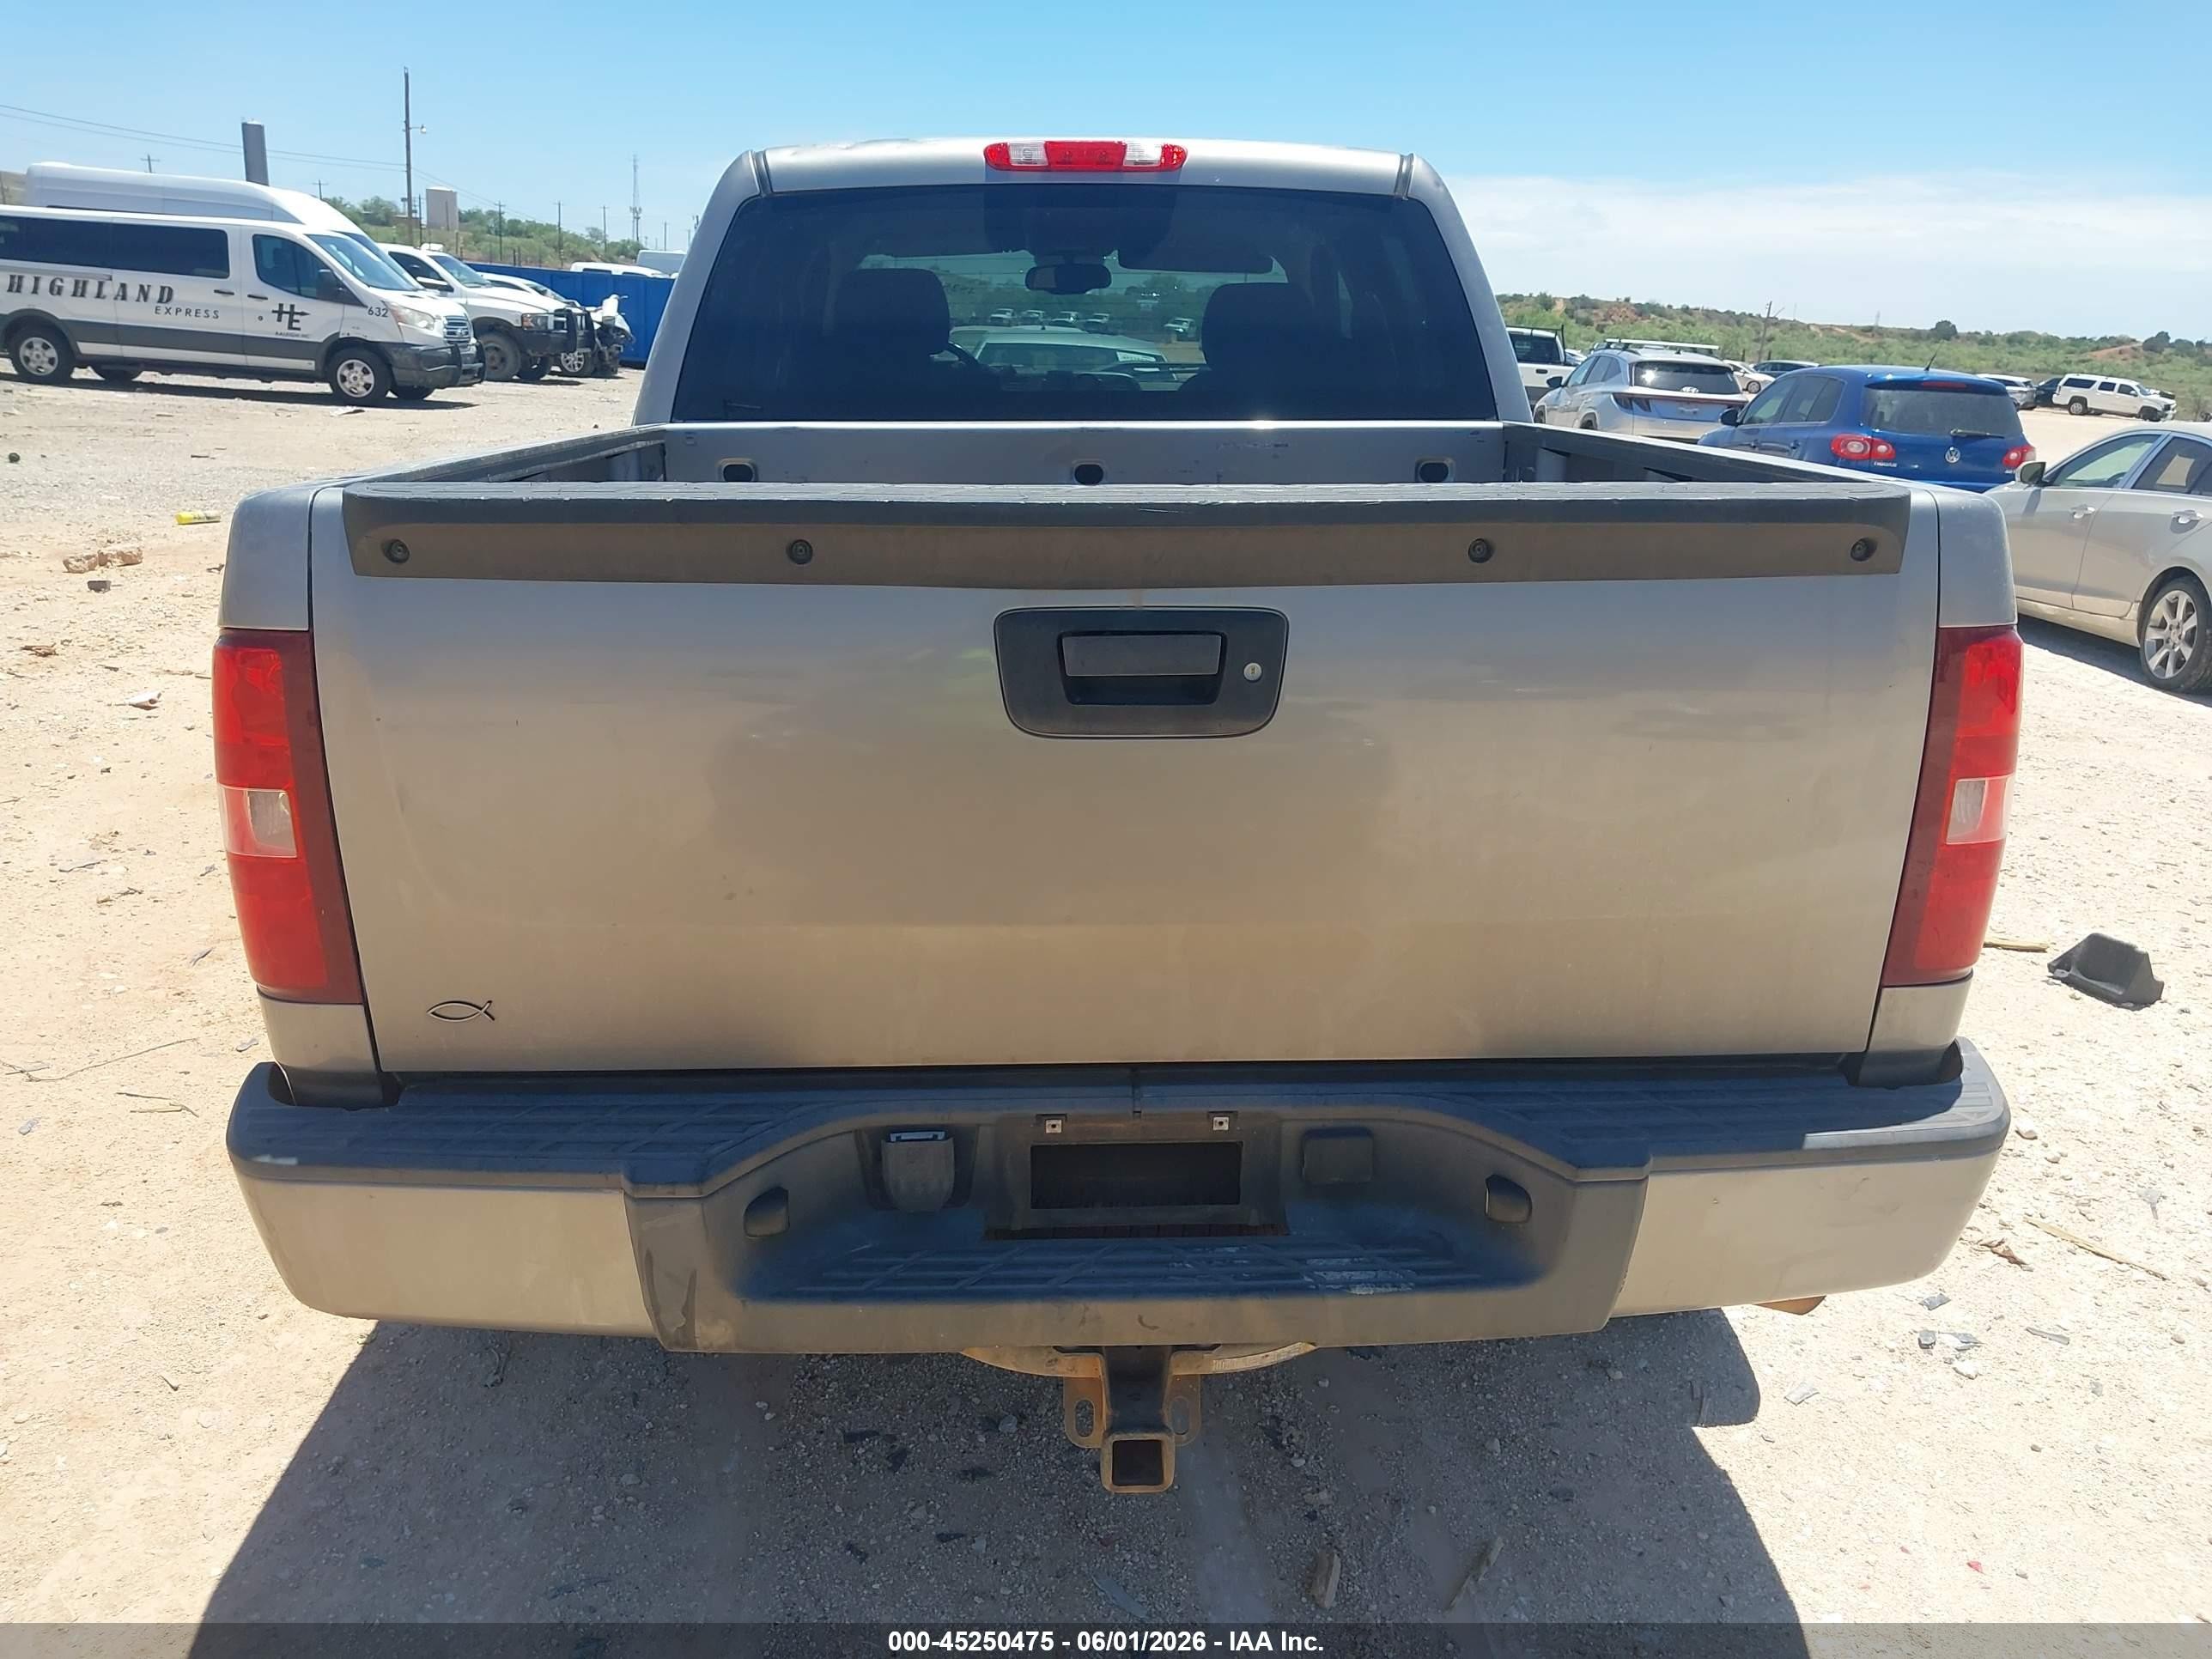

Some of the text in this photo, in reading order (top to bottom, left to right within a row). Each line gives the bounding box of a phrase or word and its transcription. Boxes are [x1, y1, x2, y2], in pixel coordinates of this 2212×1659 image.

[7, 274, 174, 303] HIGHLAND
[155, 306, 220, 319] EXPRESS
[368, 307, 388, 318] 632
